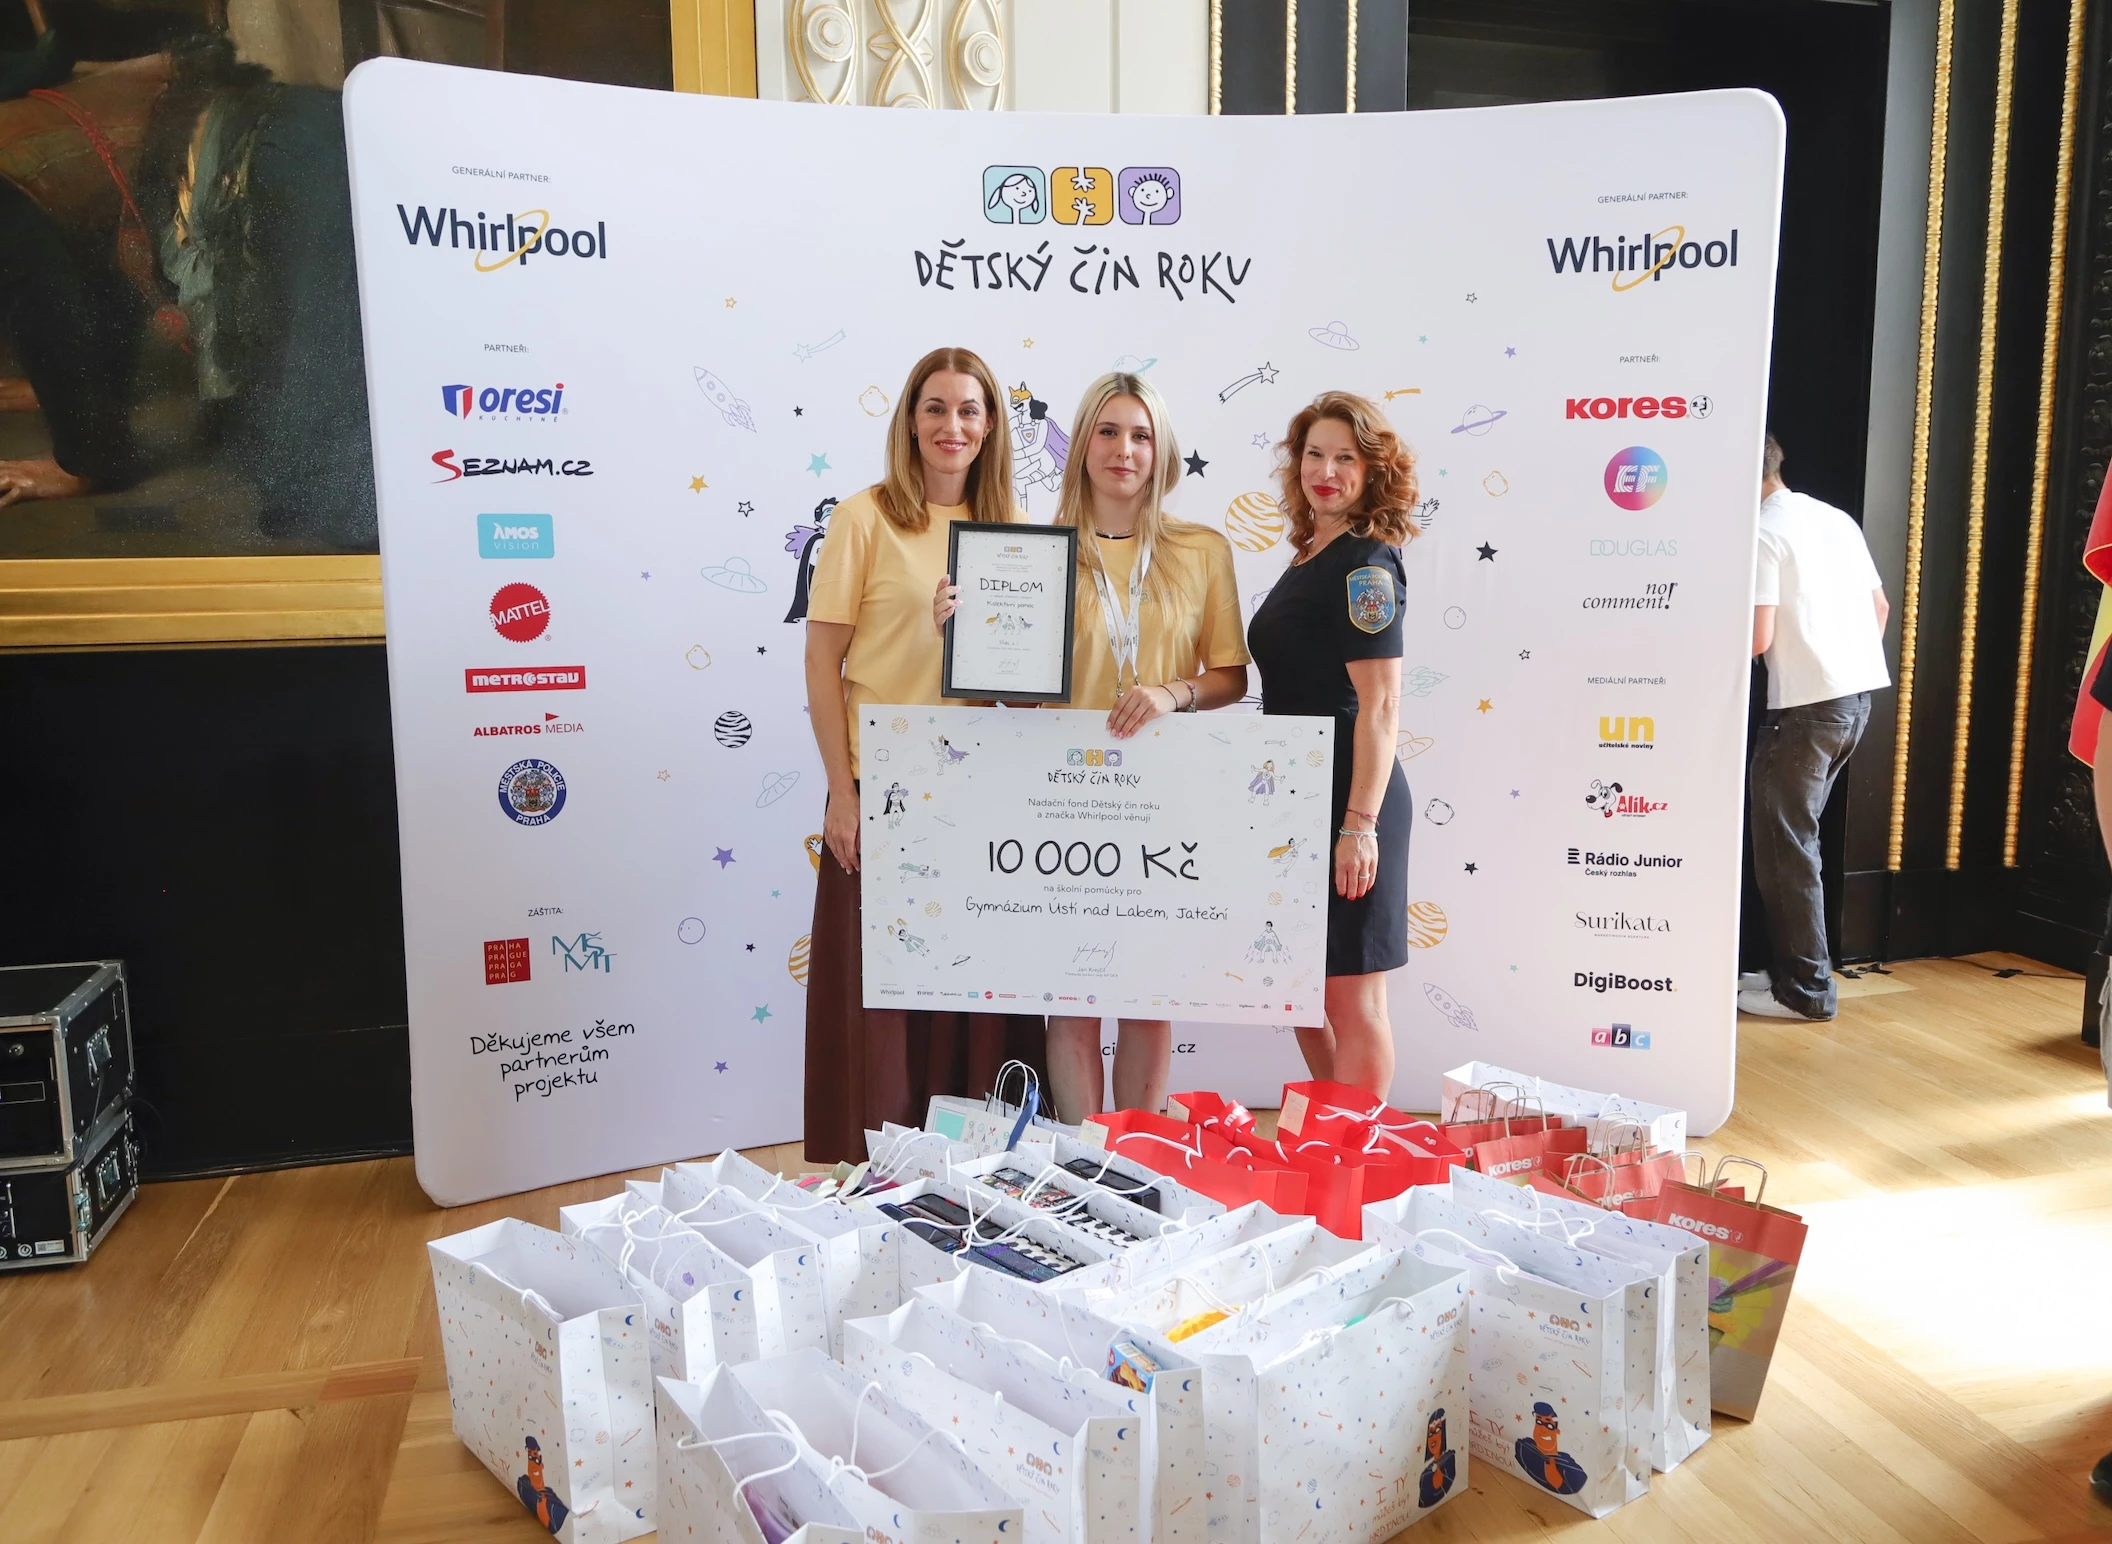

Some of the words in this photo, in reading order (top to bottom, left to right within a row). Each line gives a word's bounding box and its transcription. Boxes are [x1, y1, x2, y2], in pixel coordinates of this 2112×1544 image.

[452, 165, 506, 179] GENERÁLNÍ
[508, 171, 551, 183] PARTNER:
[1597, 192, 1647, 204] GENERÁLNÍ
[1648, 191, 1689, 201] PARTNER:
[396, 203, 607, 266] Whirlpool
[1546, 228, 1739, 282] Whirlpool
[913, 237, 1053, 292] DĚTSKÝ
[1157, 250, 1251, 304] ROKU
[484, 343, 530, 354] PARTNEŘI:
[1619, 354, 1661, 364] PARTNEŘI:
[478, 382, 565, 415] oresi
[1565, 395, 1688, 420] kores
[1613, 464, 1660, 493] EF
[493, 541, 540, 551] vision
[1589, 539, 1678, 557] DOUGLAS
[979, 578, 1043, 593] DIPLOM
[1645, 582, 1668, 595] no
[490, 599, 551, 629] MATTEL
[1587, 675, 1627, 685] MEDIÁLNÍ
[473, 724, 542, 737] ALBATROS
[545, 722, 584, 734] MEDIA
[1599, 716, 1655, 742] un
[1630, 743, 1654, 751] noviny
[537, 760, 566, 792] POLICIE
[1047, 768, 1086, 784] DĚTSKÝ
[1114, 773, 1142, 788] ROKU
[1028, 798, 1066, 807] Nadační
[1068, 798, 1089, 808] fond
[1091, 799, 1122, 811] Dětský
[1124, 801, 1138, 810] čin
[1139, 801, 1160, 811] roku
[1616, 795, 1669, 814] Alík.cz
[515, 813, 551, 826] PRAHA
[1045, 810, 1075, 820] značka
[1077, 811, 1122, 822] Whirlpool
[1124, 813, 1152, 824] věnují
[988, 838, 1024, 875] 10
[1034, 840, 1122, 878] 000
[1141, 840, 1200, 881] Kč
[1585, 851, 1630, 867] Rádio
[1633, 853, 1683, 868] Junior
[1584, 867, 1608, 878] Český
[1609, 870, 1637, 878] rozhlas
[1043, 885, 1055, 893] na
[1056, 884, 1082, 893] školní
[1084, 885, 1124, 897] pomůcky
[1126, 888, 1143, 897] pro
[527, 907, 564, 917] ZÁŠTITA:
[965, 895, 1043, 919] Gymnázium
[1048, 896, 1078, 916] Ústí
[1083, 903, 1110, 917] nad
[1116, 904, 1169, 921] Labem,
[1175, 905, 1229, 922] Jateční
[1574, 911, 1671, 933] Surikata
[470, 1029, 573, 1056] Děkujeme
[582, 1018, 635, 1041] všem
[1593, 1027, 1646, 1047] abc
[500, 1045, 609, 1082] partnerům
[514, 1067, 598, 1103] projektu
[1487, 1157, 1533, 1178] kores
[1667, 1212, 1730, 1240] kores
